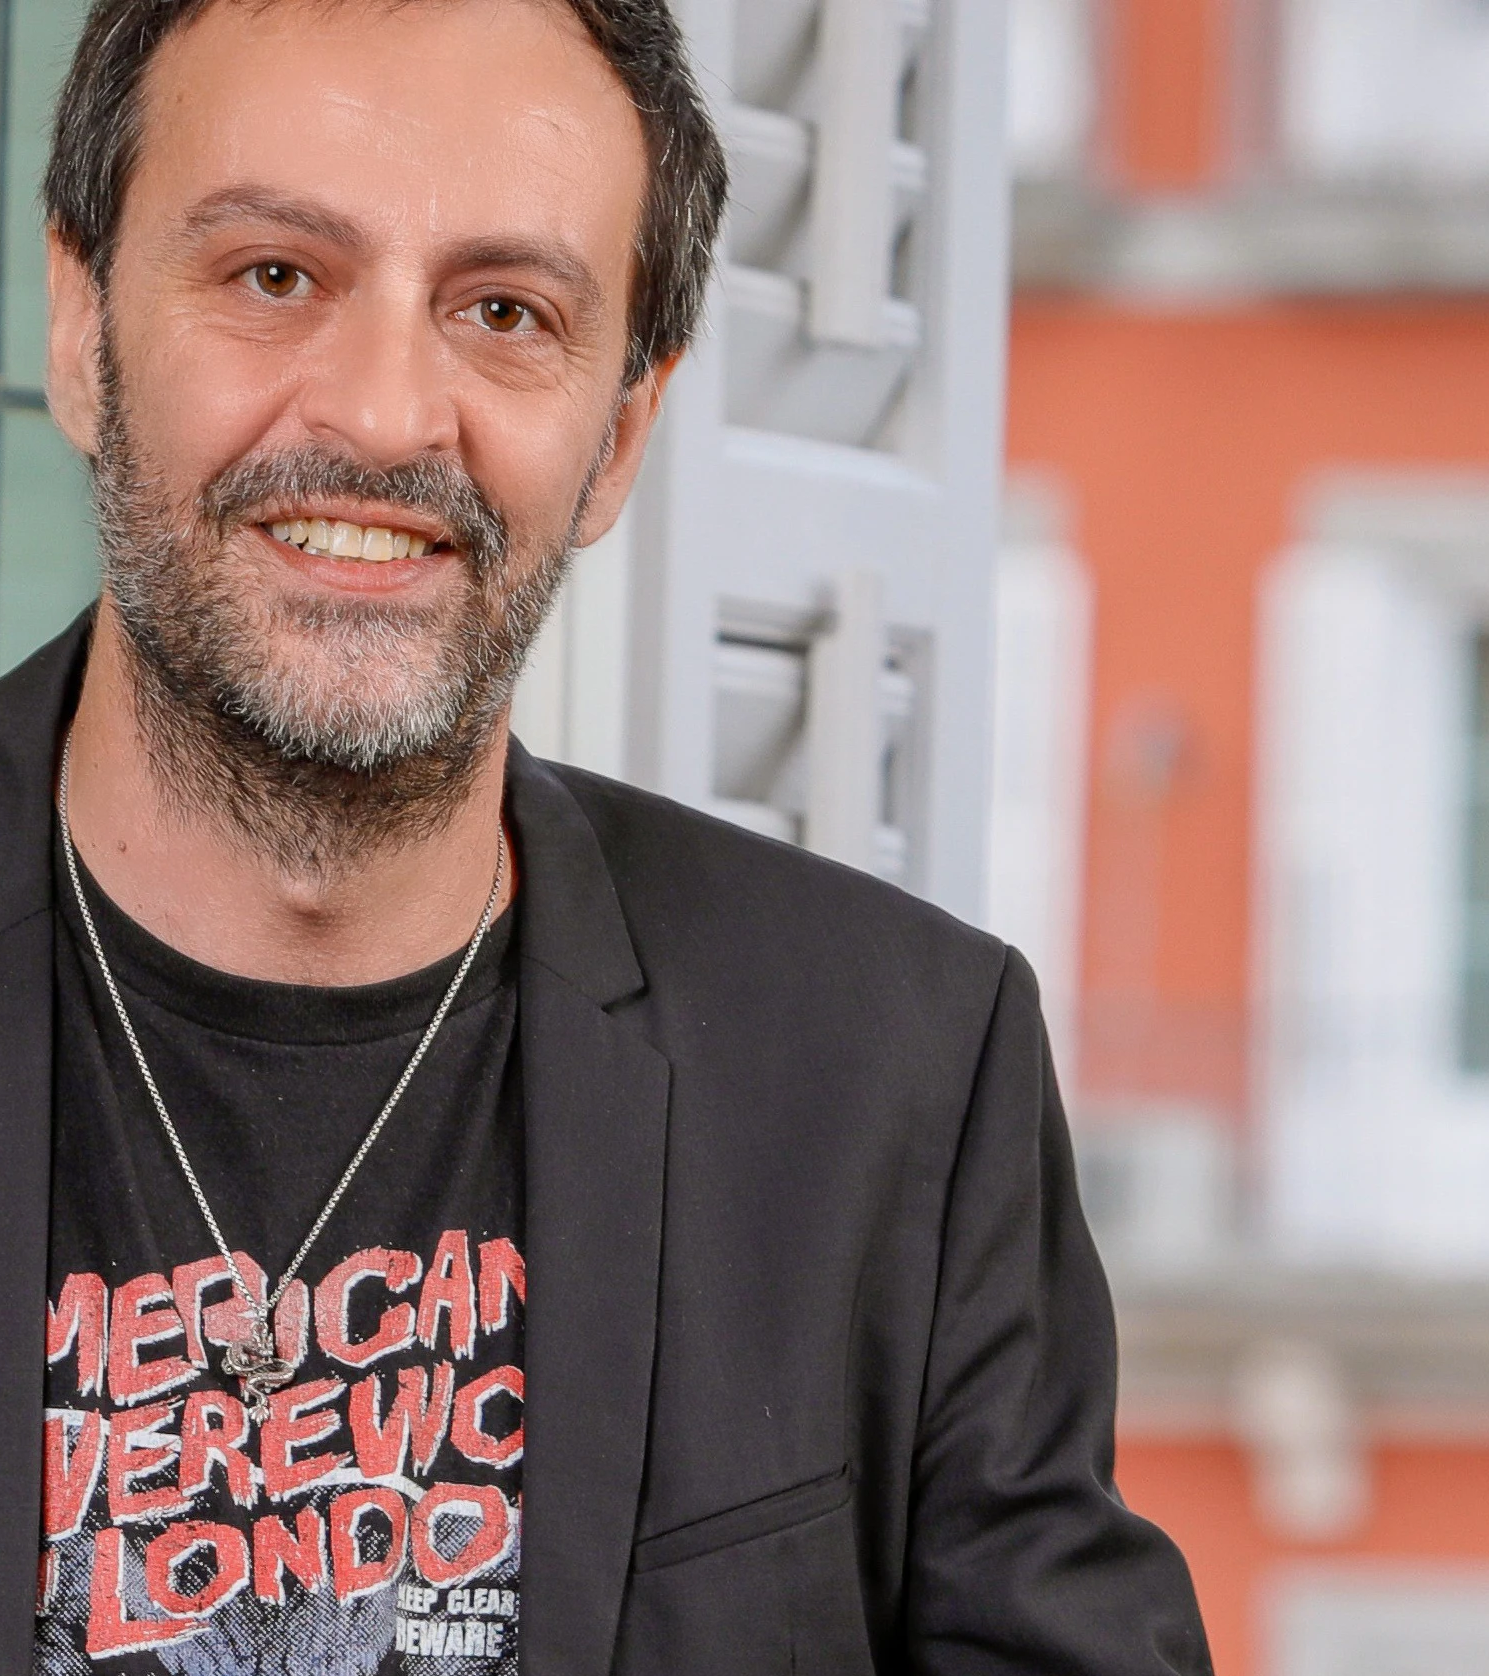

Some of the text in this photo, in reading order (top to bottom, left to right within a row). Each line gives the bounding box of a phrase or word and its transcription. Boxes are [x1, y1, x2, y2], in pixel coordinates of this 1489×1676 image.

[46, 1229, 525, 1405] MERICAN
[43, 1358, 525, 1542] WEREWO
[86, 1482, 523, 1660] LONDO
[447, 1588, 516, 1617] CLEAR
